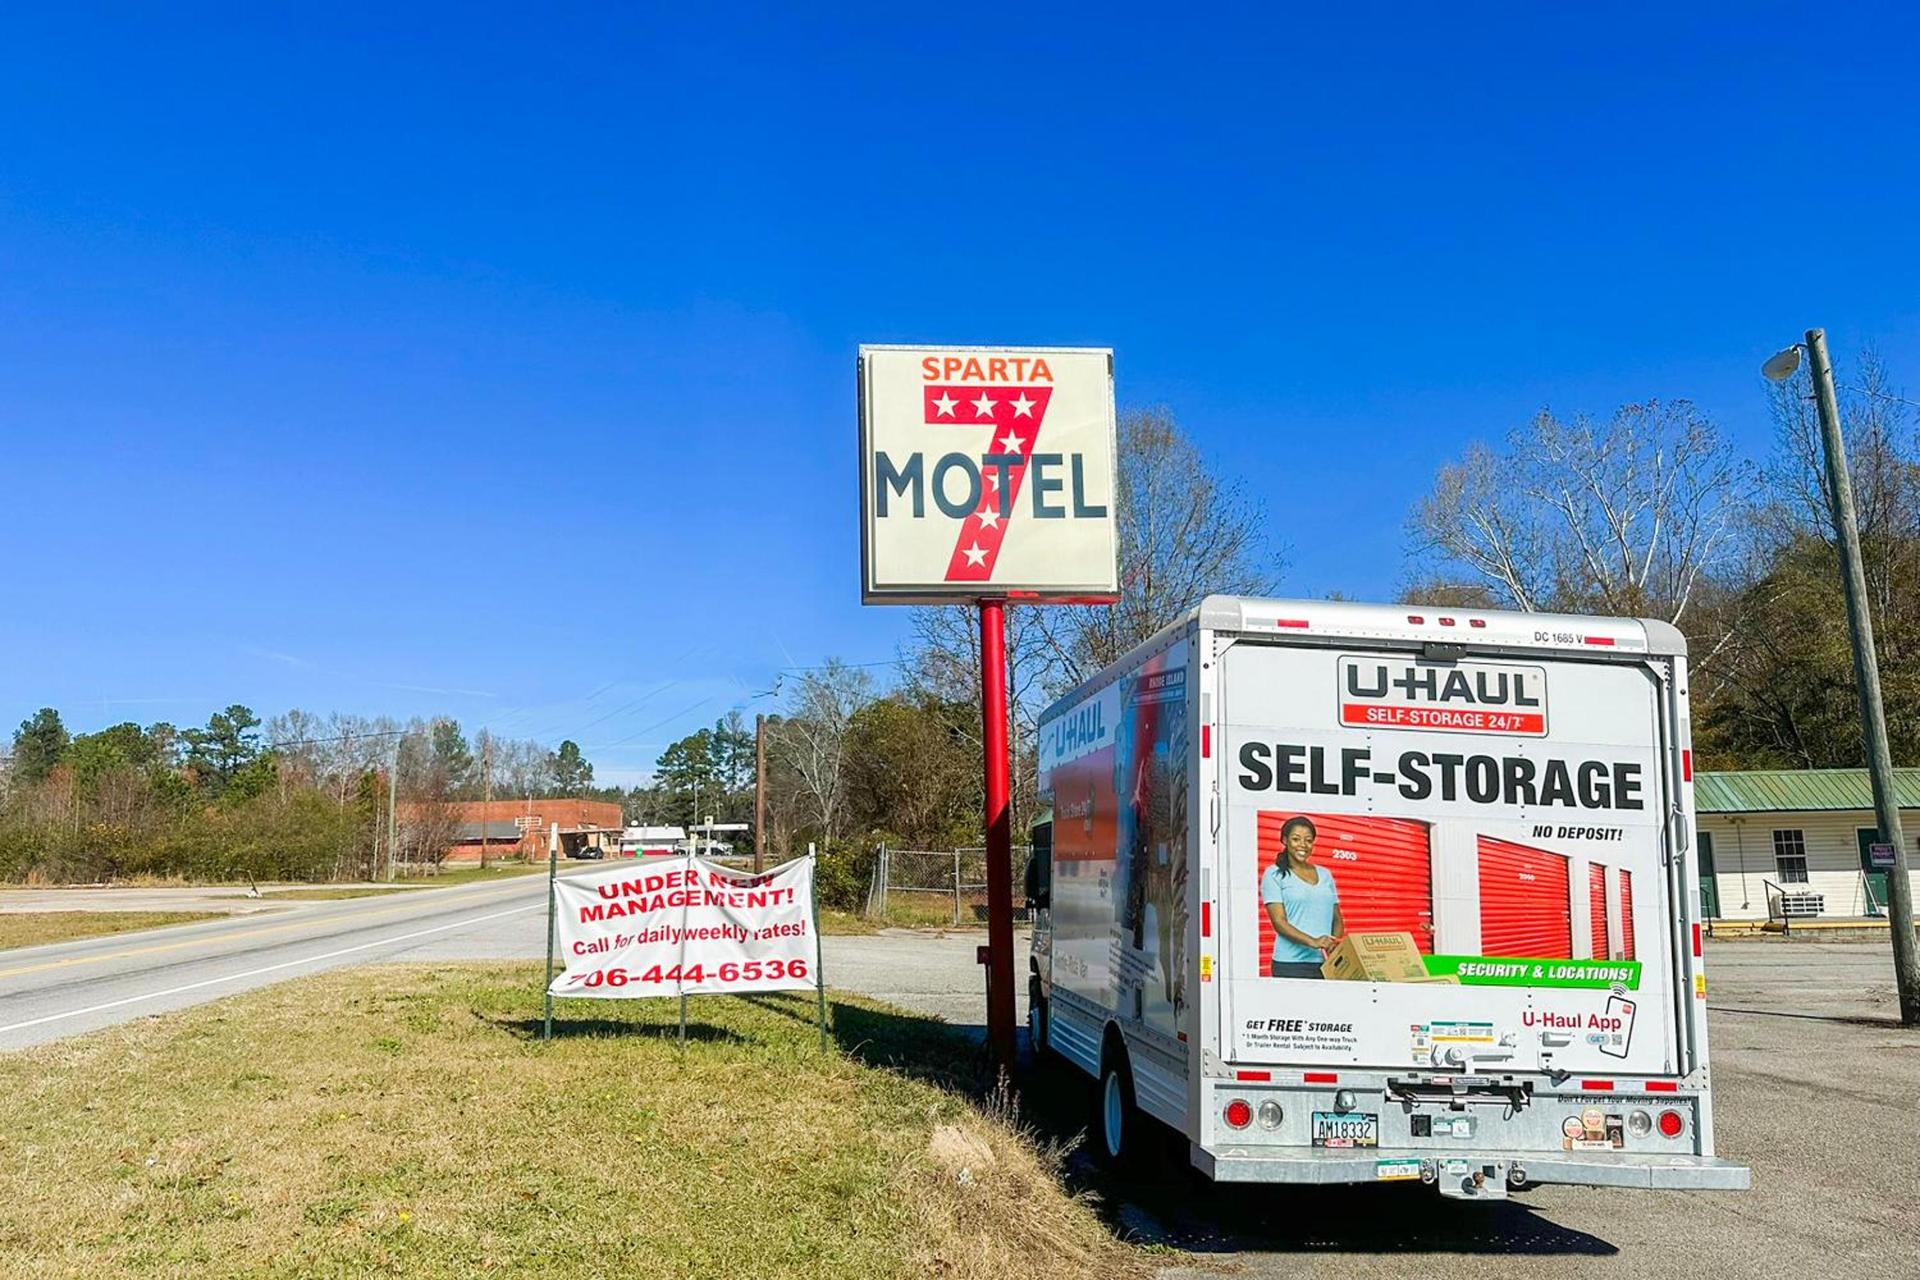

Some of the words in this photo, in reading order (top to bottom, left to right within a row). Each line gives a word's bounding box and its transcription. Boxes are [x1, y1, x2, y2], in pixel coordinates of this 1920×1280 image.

[922, 357, 1054, 382] SPARTA
[875, 451, 1107, 519] MOTEL
[924, 385, 1054, 581] 7
[1534, 631, 1549, 642] DC
[1552, 633, 1574, 643] 1685
[1347, 664, 1539, 707] U-HAUL
[1055, 700, 1105, 757] U-HAUL
[1366, 708, 1484, 728] SELF-STORAGE
[1488, 715, 1521, 730] 24/7
[1238, 741, 1644, 810] SELF-STORAGE
[1532, 825, 1552, 838] NO
[1557, 827, 1623, 841] DEPOSIT!
[597, 869, 698, 900] UNDER
[709, 872, 775, 889] NEW
[579, 887, 794, 924] MANAGEMENT!
[573, 937, 609, 956] Call
[614, 933, 635, 951] for
[754, 919, 806, 942] rates!
[567, 959, 808, 988] 706-444-6536
[1457, 962, 1529, 978] SECURITY
[1533, 967, 1544, 978] &
[1548, 966, 1634, 981] LOCATIONS!
[1246, 1020, 1265, 1030] GET
[1308, 1022, 1353, 1033] STORAGE
[1522, 1012, 1582, 1028] U-Haul
[1588, 1013, 1622, 1032] App
[1318, 1121, 1371, 1139] AM18332
